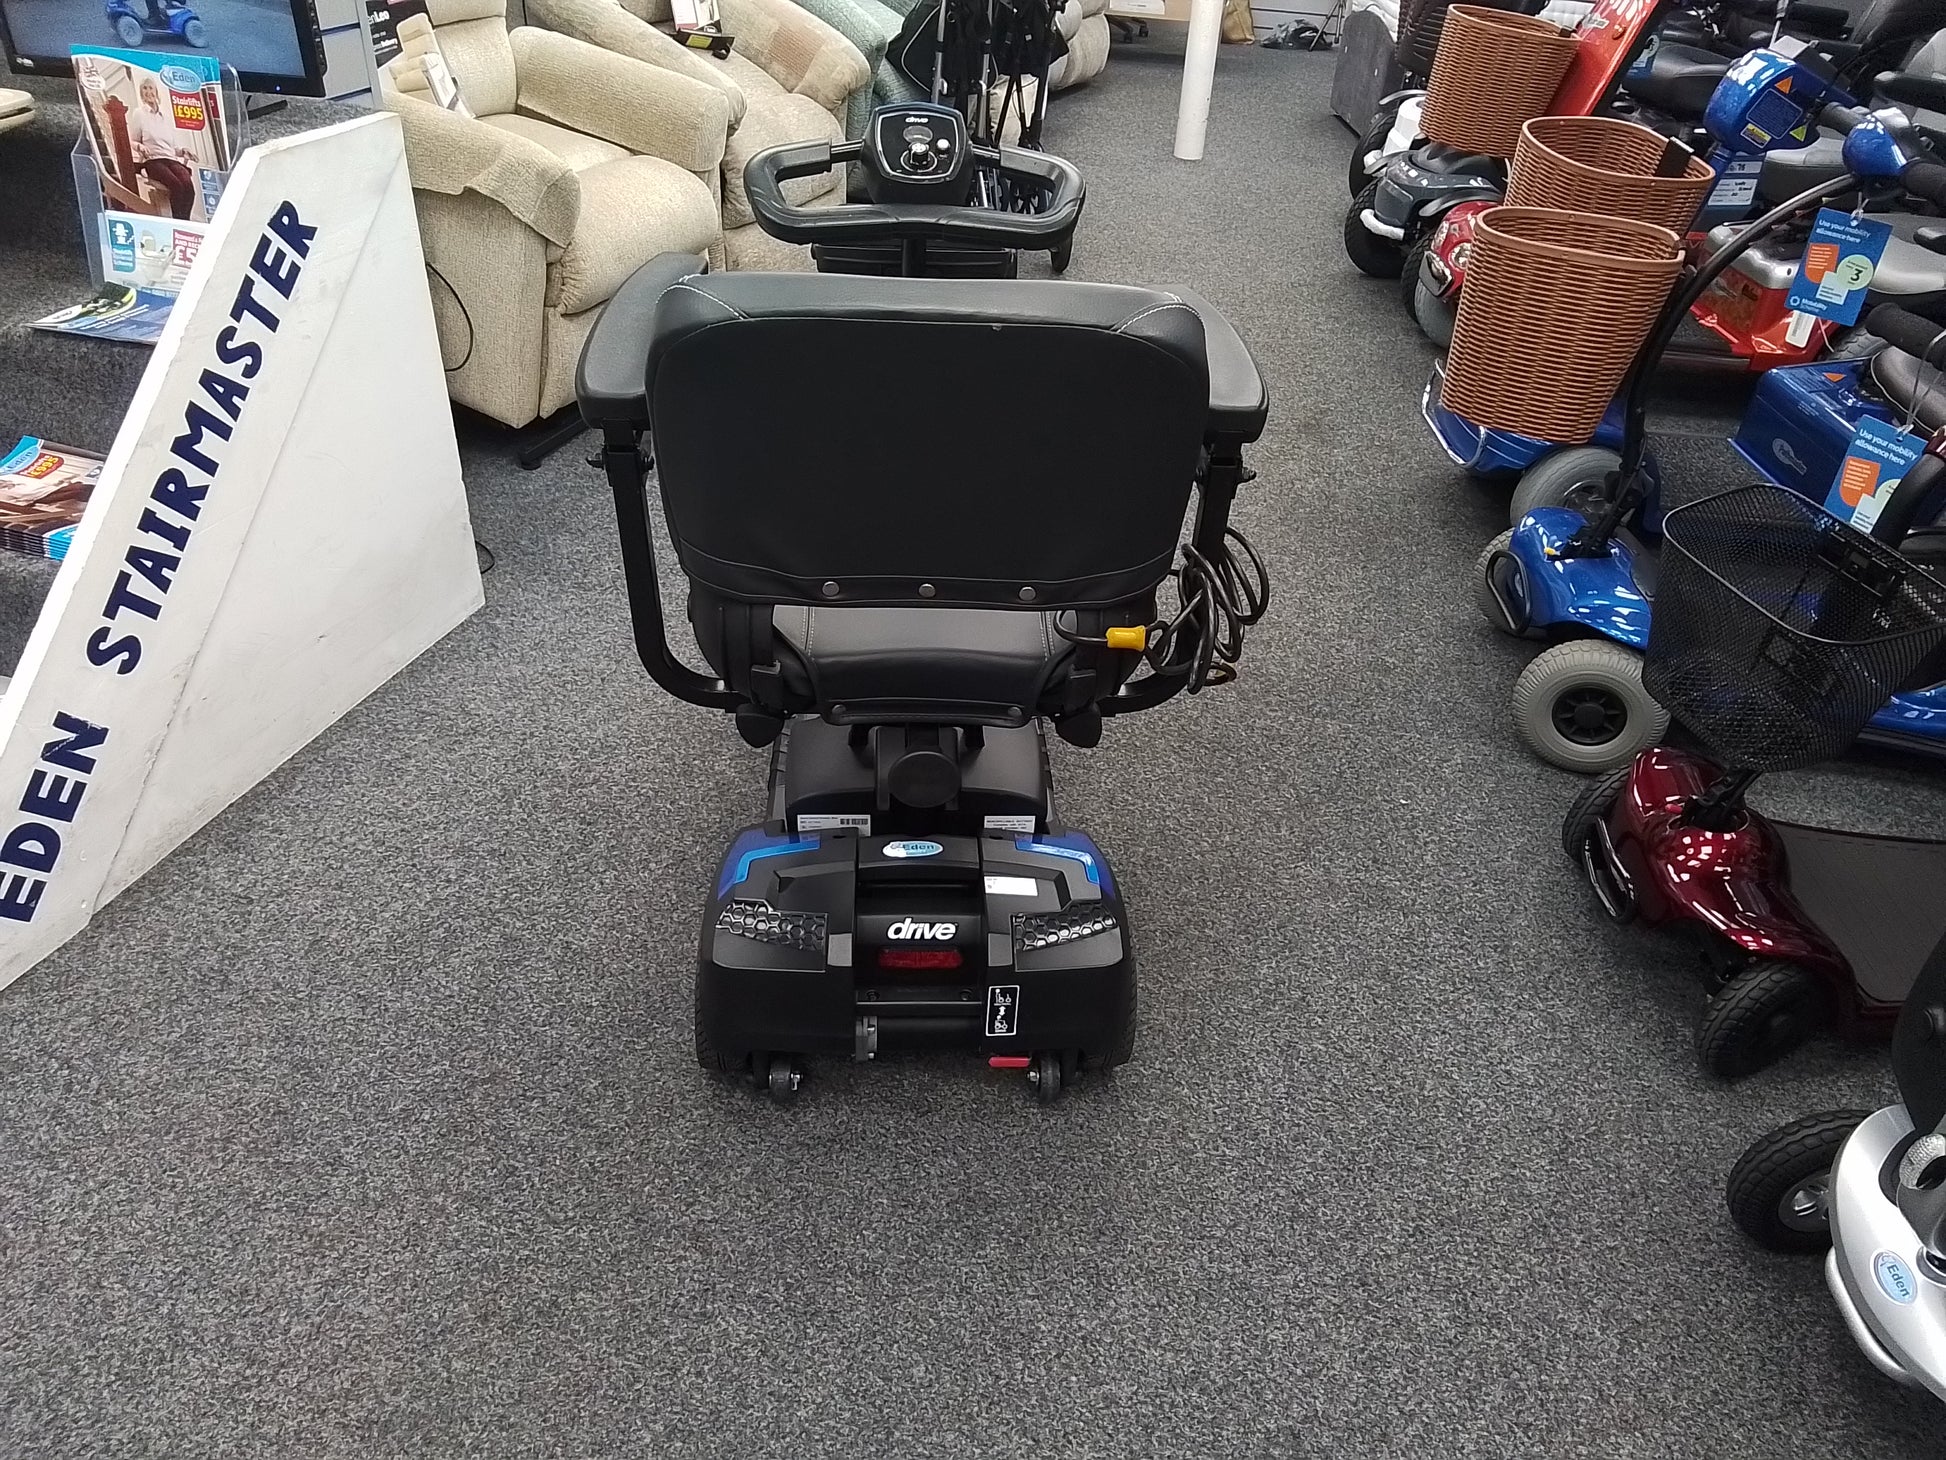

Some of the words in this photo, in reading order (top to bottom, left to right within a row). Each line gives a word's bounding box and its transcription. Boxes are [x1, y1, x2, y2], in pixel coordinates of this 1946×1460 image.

[172, 72, 196, 84] Eden
[1815, 228, 1847, 240] allowance
[1846, 234, 1862, 244] here
[1818, 219, 1831, 228] Use
[1830, 223, 1845, 231] your
[1844, 227, 1872, 239] mobility
[1850, 268, 1864, 282] 3
[1855, 439, 1888, 458] allowance
[1888, 454, 1906, 466] here
[1859, 428, 1873, 440] Use
[1871, 434, 1890, 448] your
[1889, 443, 1918, 460] mobility
[0, 711, 110, 922] EDEN
[86, 200, 319, 675] STAIRMASTER
[902, 843, 936, 852] Eden
[887, 917, 957, 941] drive
[1886, 1263, 1911, 1297] Eden
